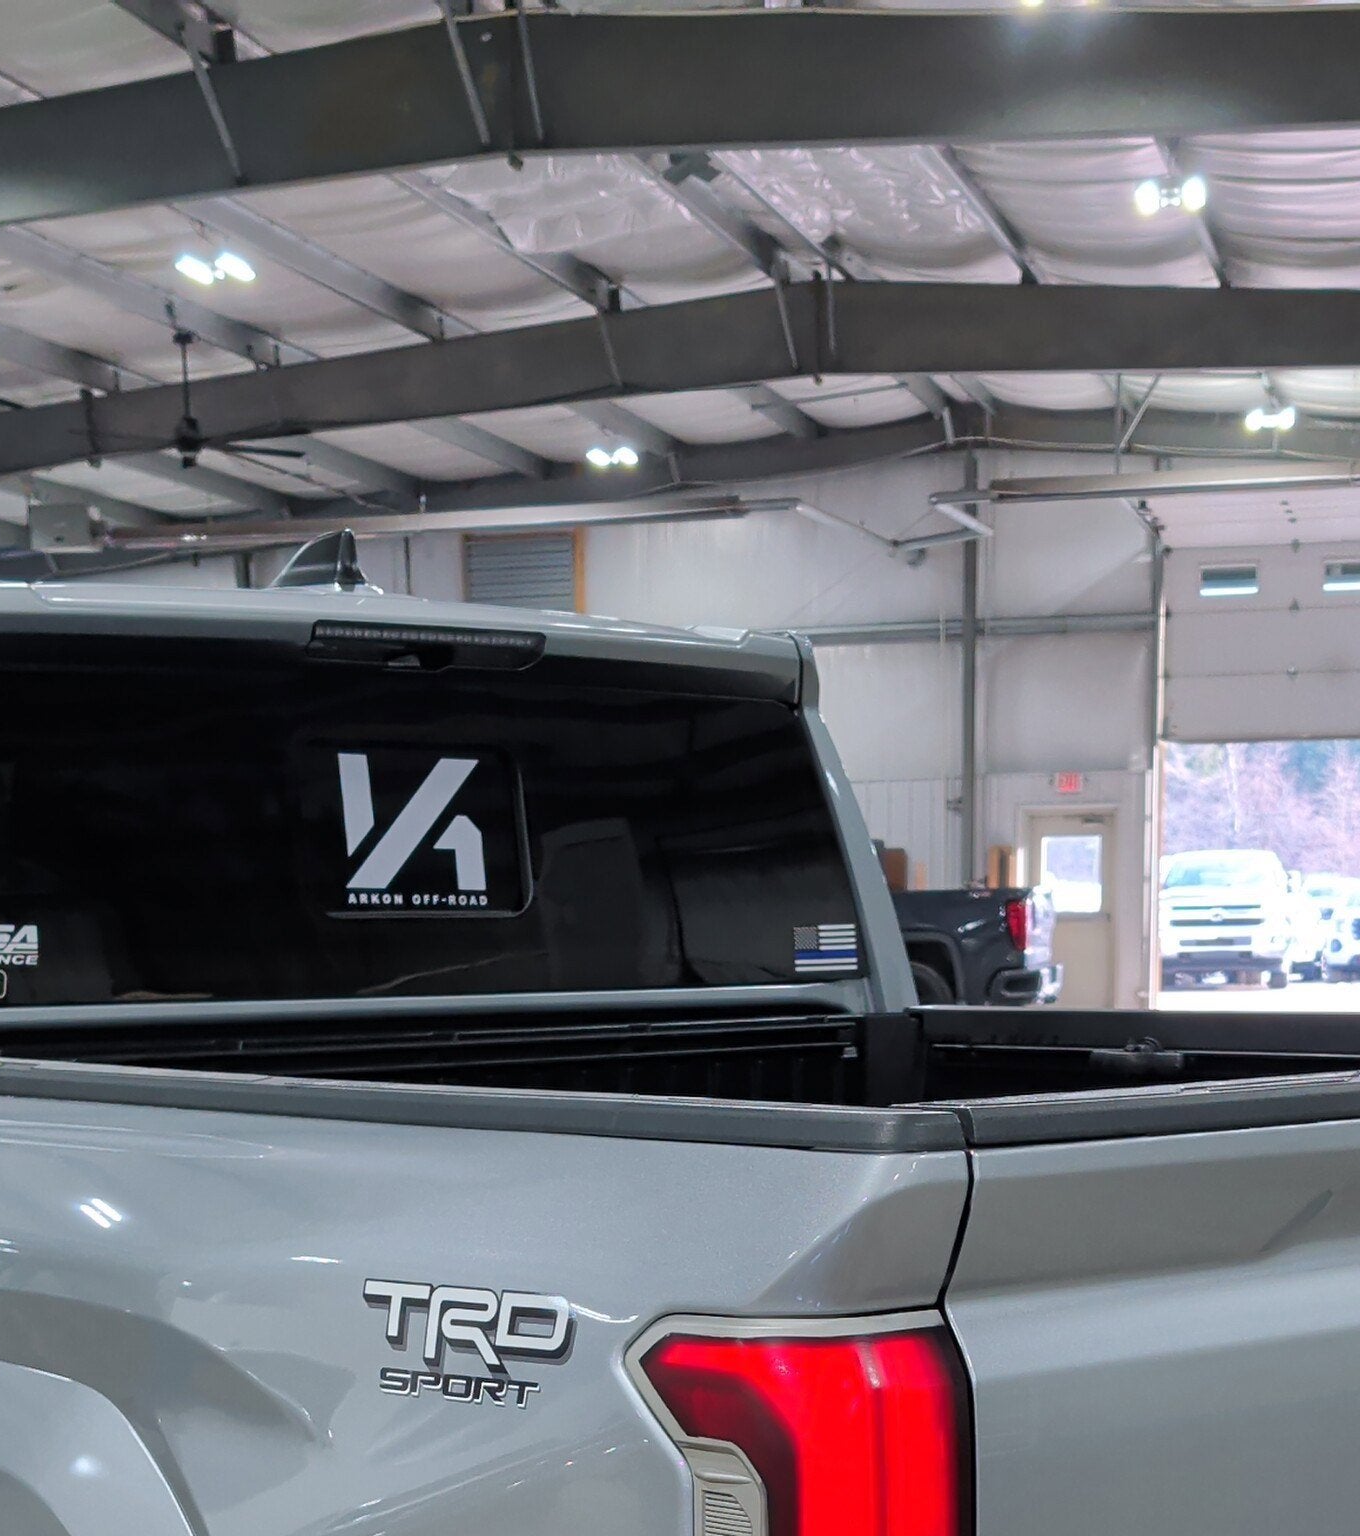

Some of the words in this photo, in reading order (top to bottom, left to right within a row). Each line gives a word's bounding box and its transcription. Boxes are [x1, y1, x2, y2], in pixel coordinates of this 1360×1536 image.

[347, 892, 404, 905] ARKON
[411, 893, 489, 906] OFF-ROAD
[362, 1278, 578, 1374] TRD
[379, 1366, 540, 1410] SPORT
